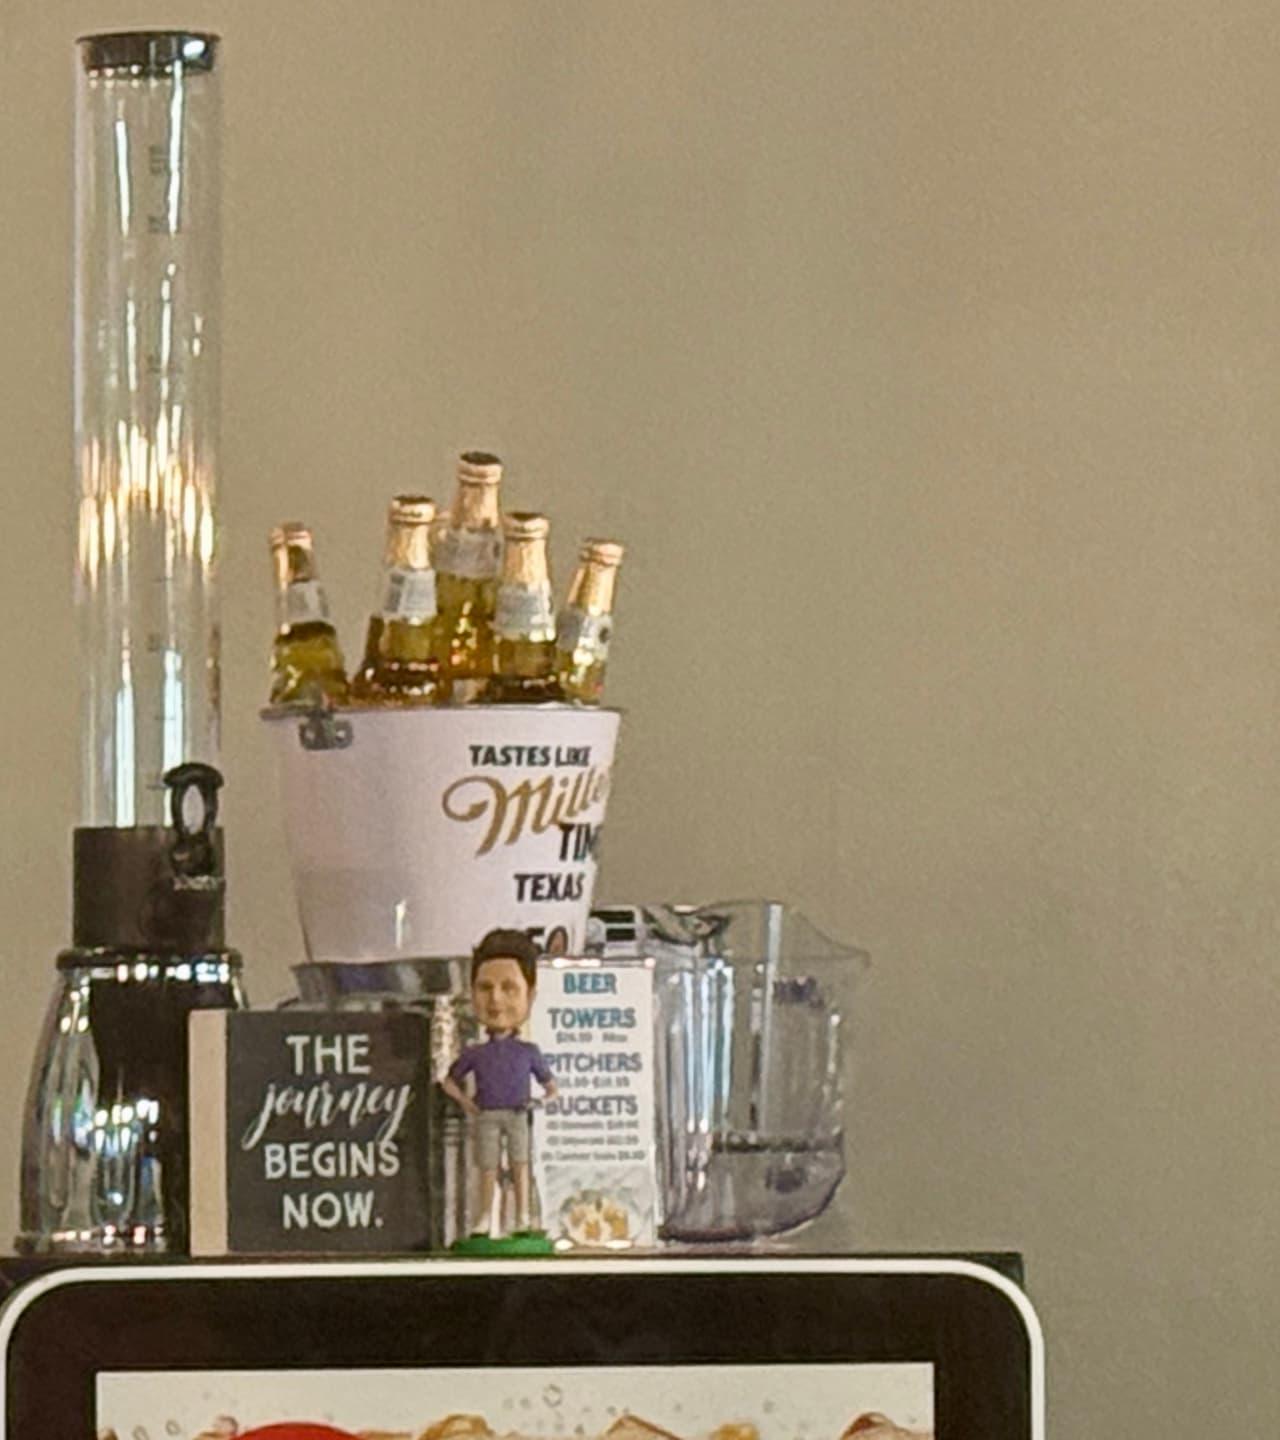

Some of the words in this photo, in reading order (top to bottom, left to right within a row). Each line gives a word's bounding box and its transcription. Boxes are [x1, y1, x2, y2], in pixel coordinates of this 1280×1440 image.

[468, 744, 551, 767] TASTES
[555, 746, 592, 767] LIKE
[513, 872, 587, 903] TEXAS
[562, 972, 618, 996] BEER
[547, 1007, 637, 1030] TOWERS
[285, 1034, 372, 1076] THE
[541, 1052, 643, 1073] PITCHERS
[241, 1080, 412, 1151] journey
[544, 1095, 639, 1117] BUCKETS
[264, 1141, 401, 1180] BEGINS
[282, 1189, 385, 1230] NOW.
